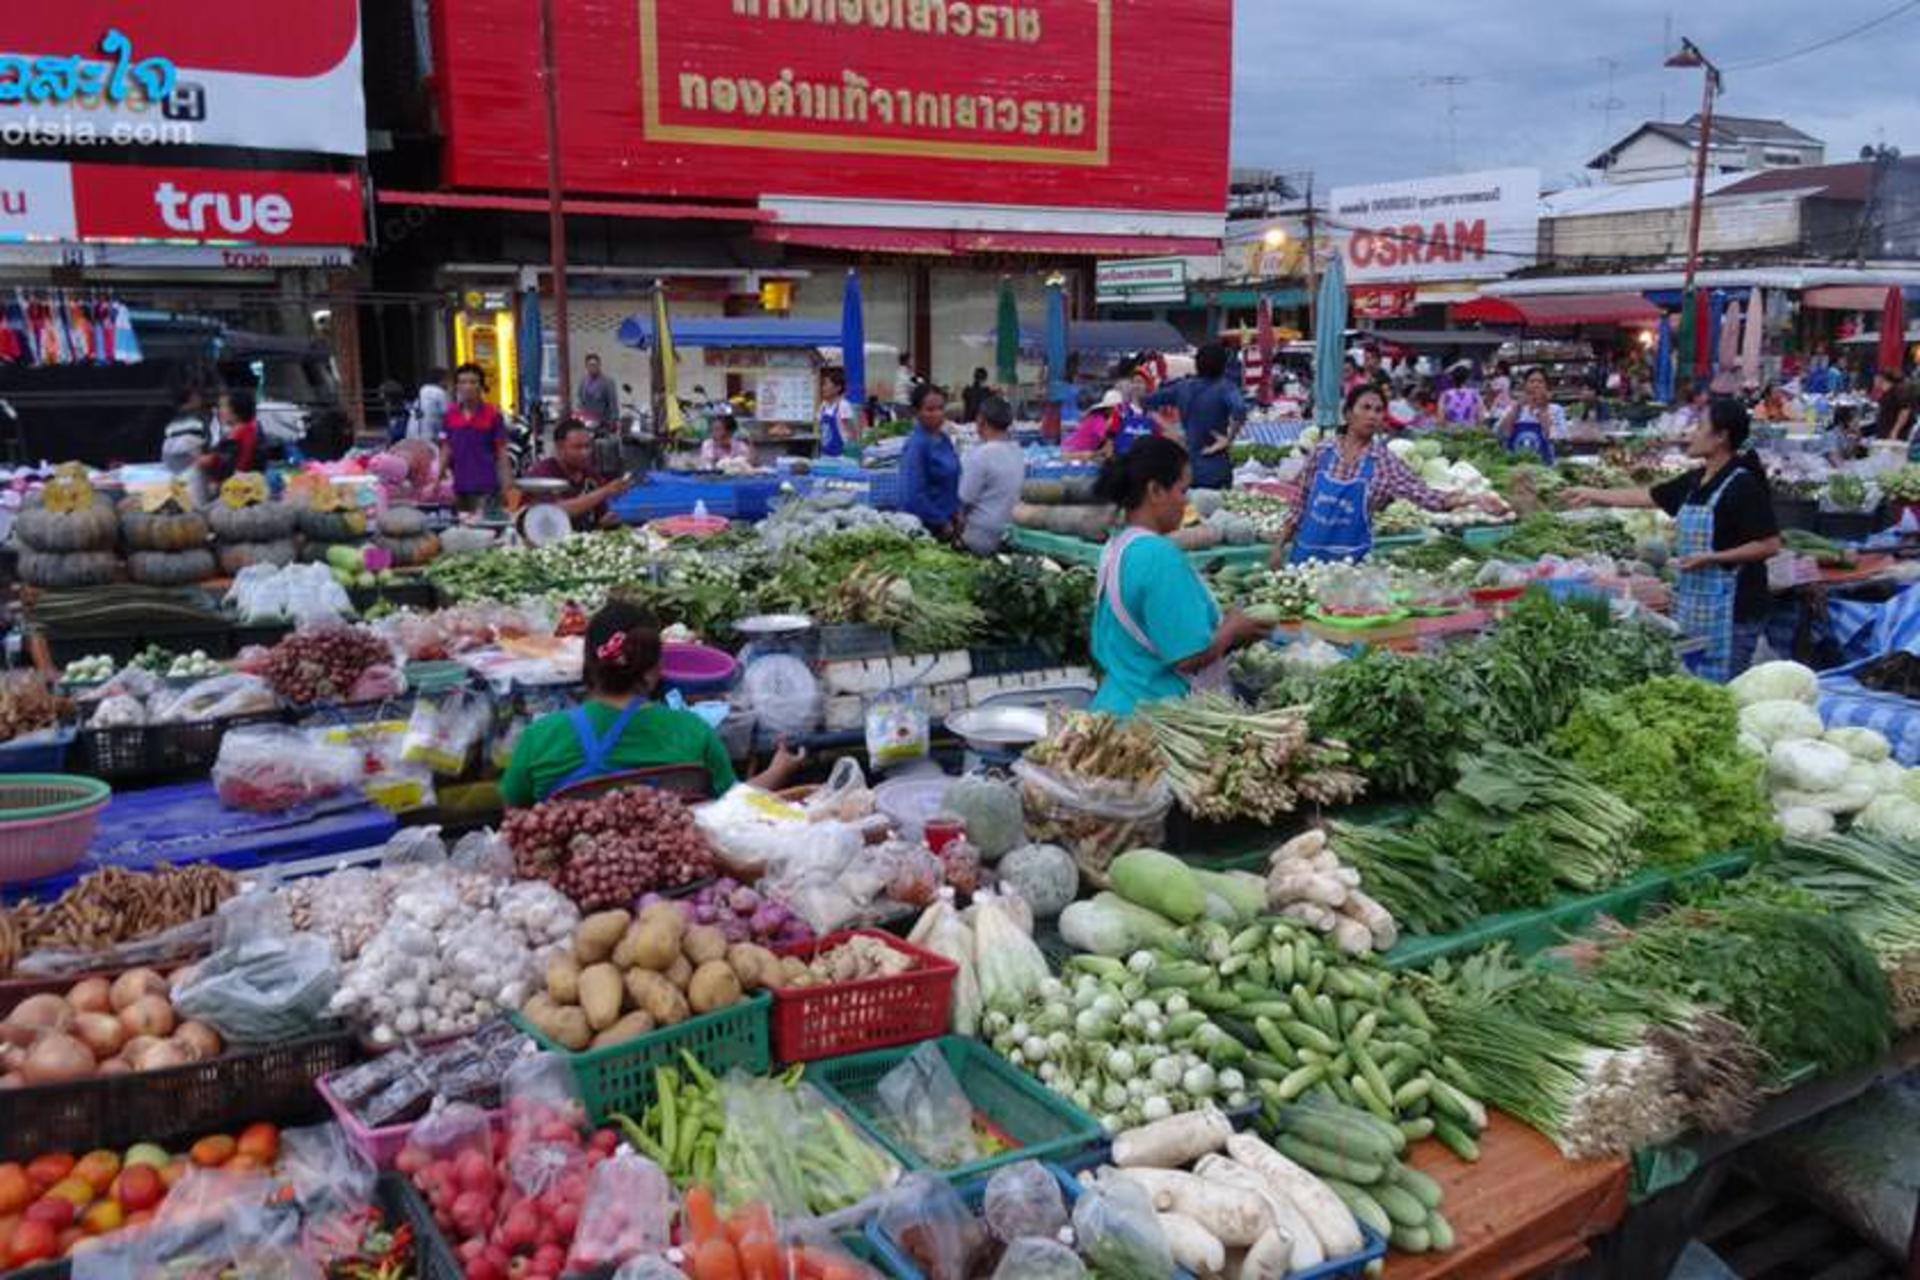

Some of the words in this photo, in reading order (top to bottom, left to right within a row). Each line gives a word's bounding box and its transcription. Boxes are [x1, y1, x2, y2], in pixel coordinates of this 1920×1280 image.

[731, 0, 1041, 43] างทองเยาวราช
[155, 182, 293, 234] true
[1349, 218, 1486, 268] OSRAM
